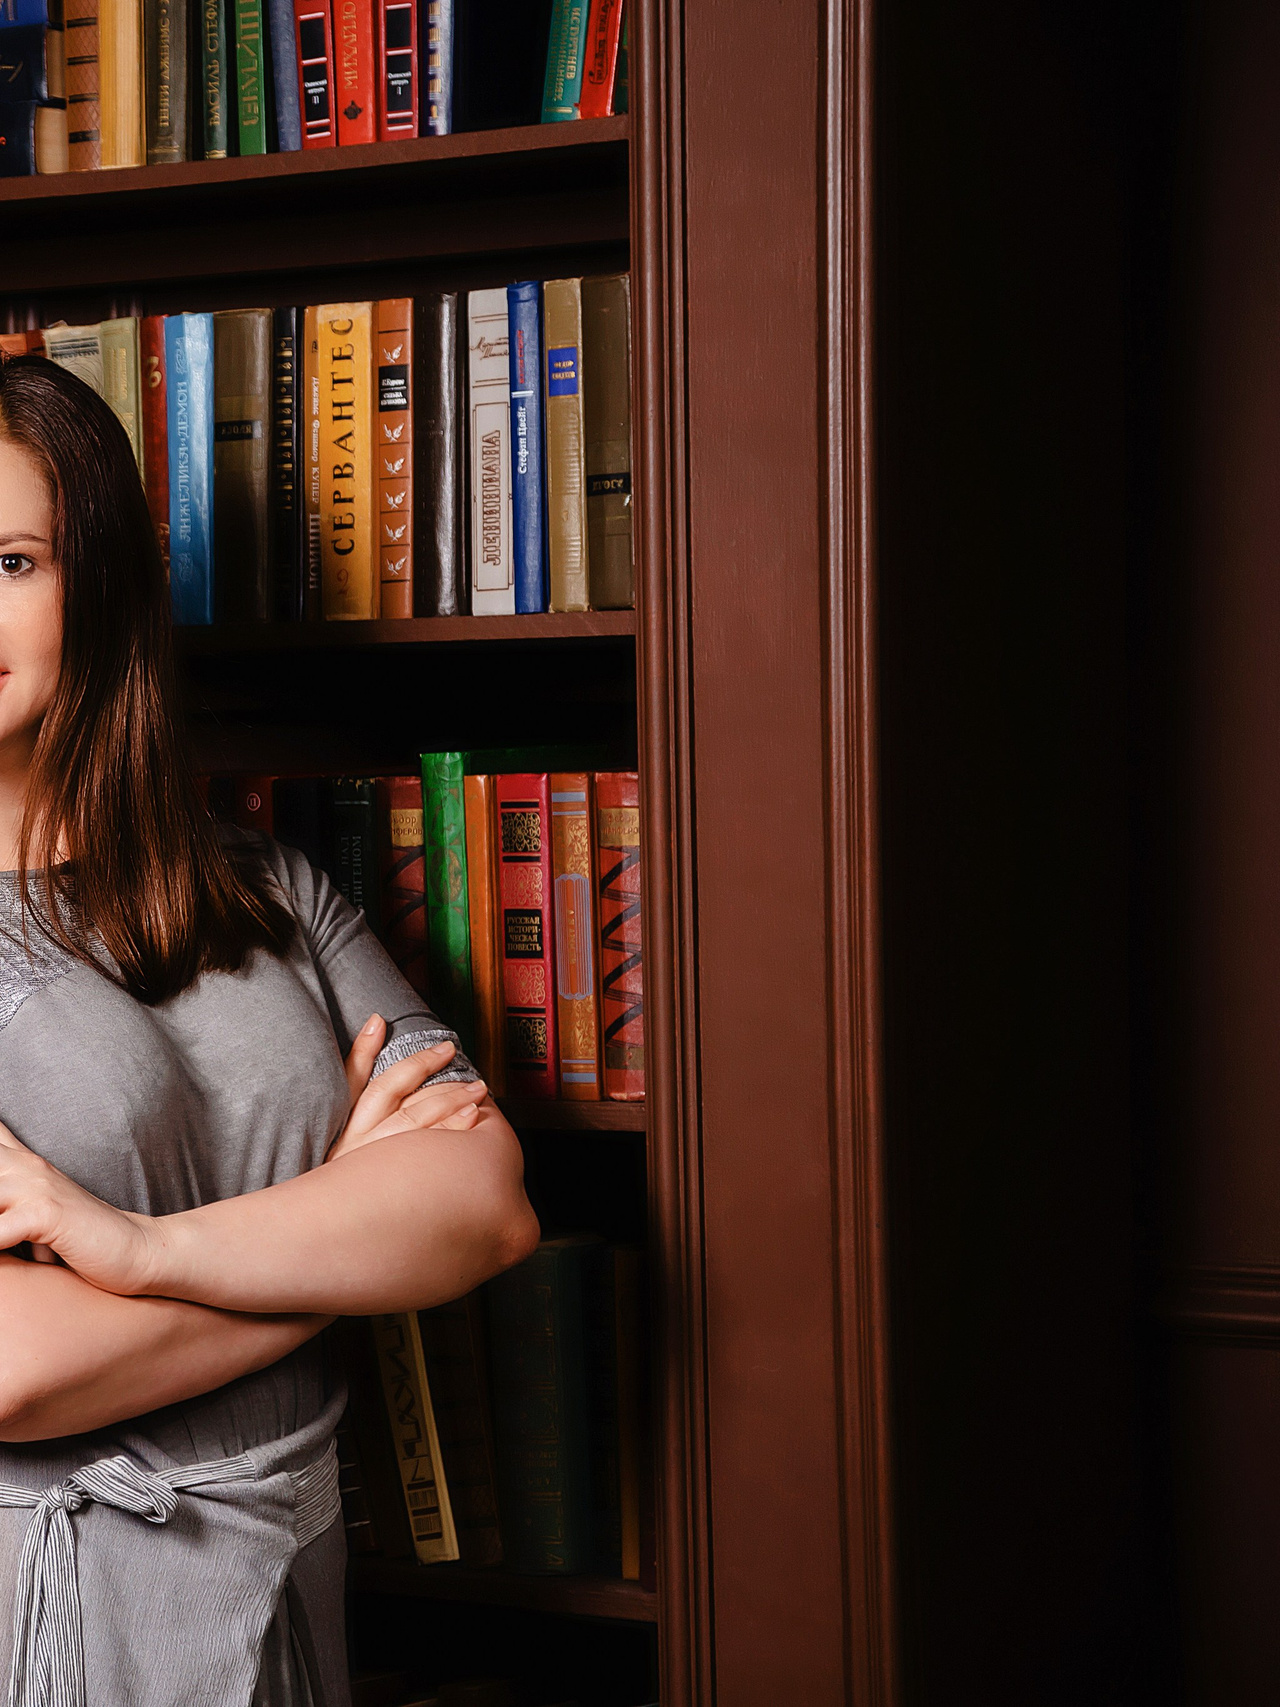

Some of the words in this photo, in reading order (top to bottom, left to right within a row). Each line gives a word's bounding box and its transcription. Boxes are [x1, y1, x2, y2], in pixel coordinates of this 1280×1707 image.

[207, 59, 221, 126] ВАСИЛЬ
[177, 381, 190, 437] ДЕМОН
[517, 407, 528, 436] Цвейг
[311, 419, 320, 462] Фенимор
[330, 317, 356, 557] СЕРВАНТЕС
[518, 438, 528, 474] Стефан
[178, 446, 192, 543] АНЖЕЛИКА
[311, 467, 320, 503] КУПЕР
[308, 513, 322, 590] ШПИОН
[507, 916, 540, 925] РУССКАЯ
[509, 934, 538, 942] ЧЕСКАЯ
[507, 943, 542, 951] ПОВЕСТЬ
